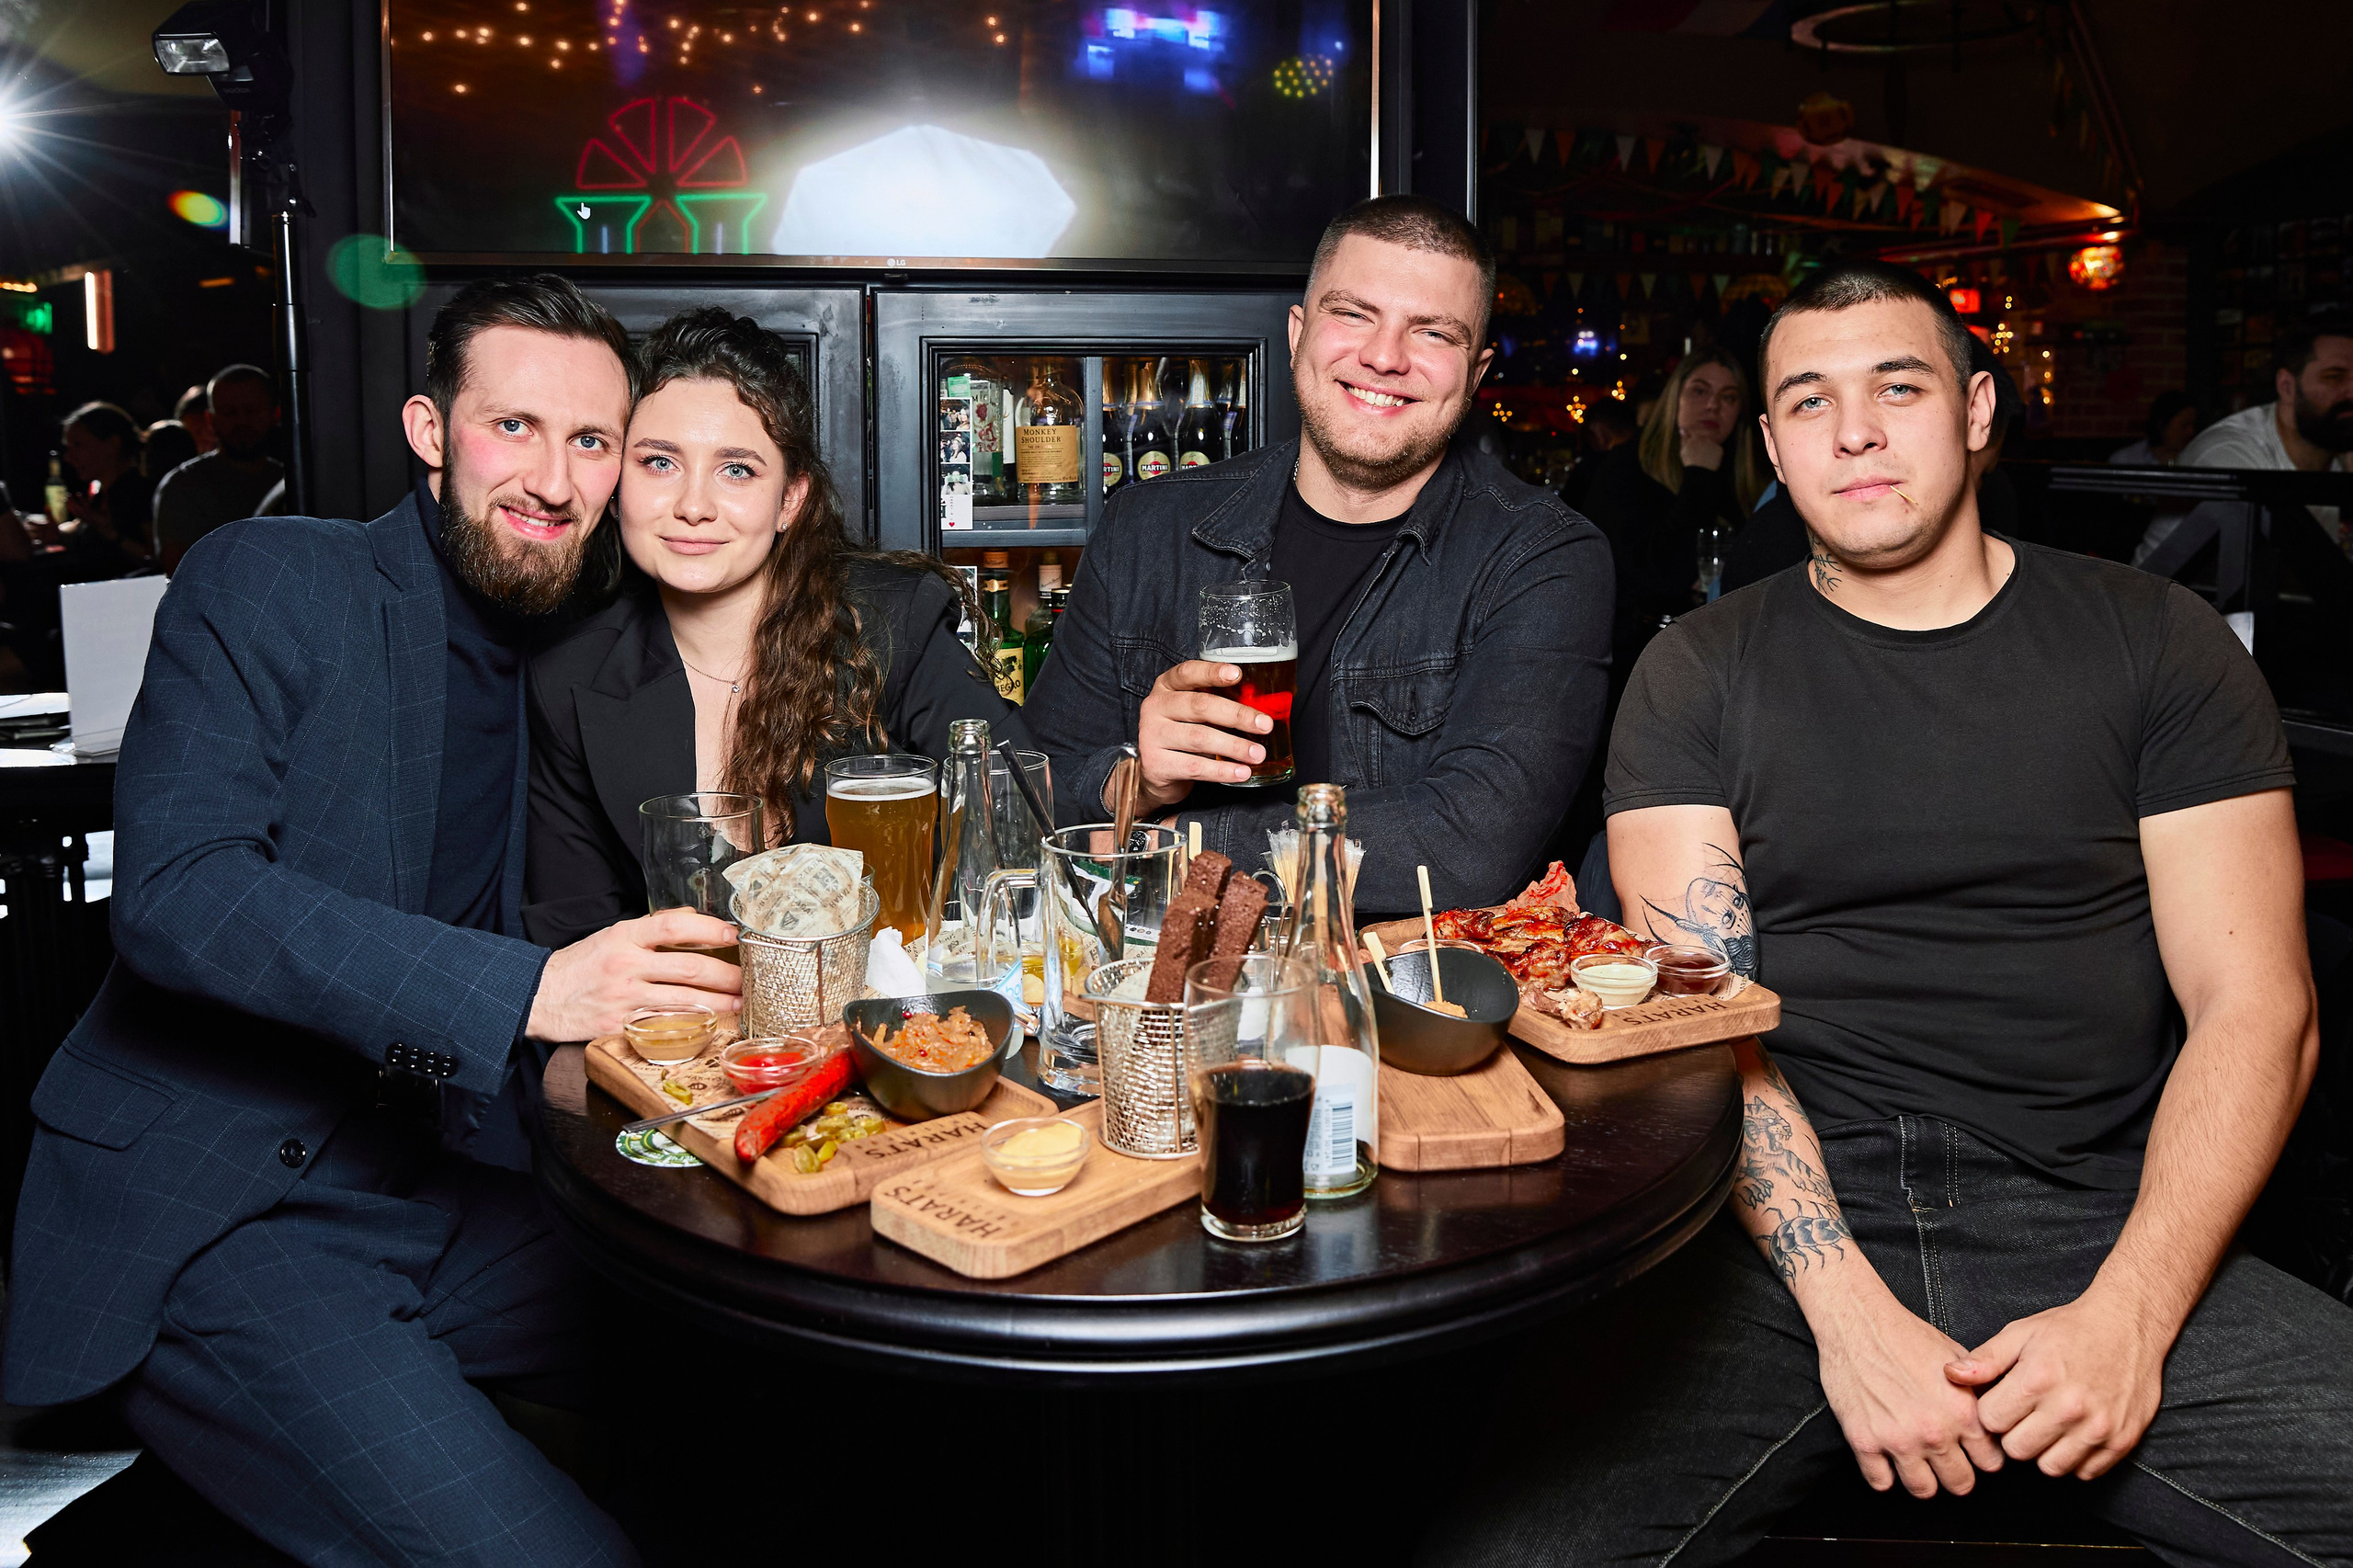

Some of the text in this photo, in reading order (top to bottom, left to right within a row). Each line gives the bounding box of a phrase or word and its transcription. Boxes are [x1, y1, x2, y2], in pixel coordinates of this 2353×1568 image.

[1021, 436, 1062, 444] SHOULDER
[1622, 1001, 1727, 1026] HARAT'S
[865, 1122, 988, 1159] HARAT'S
